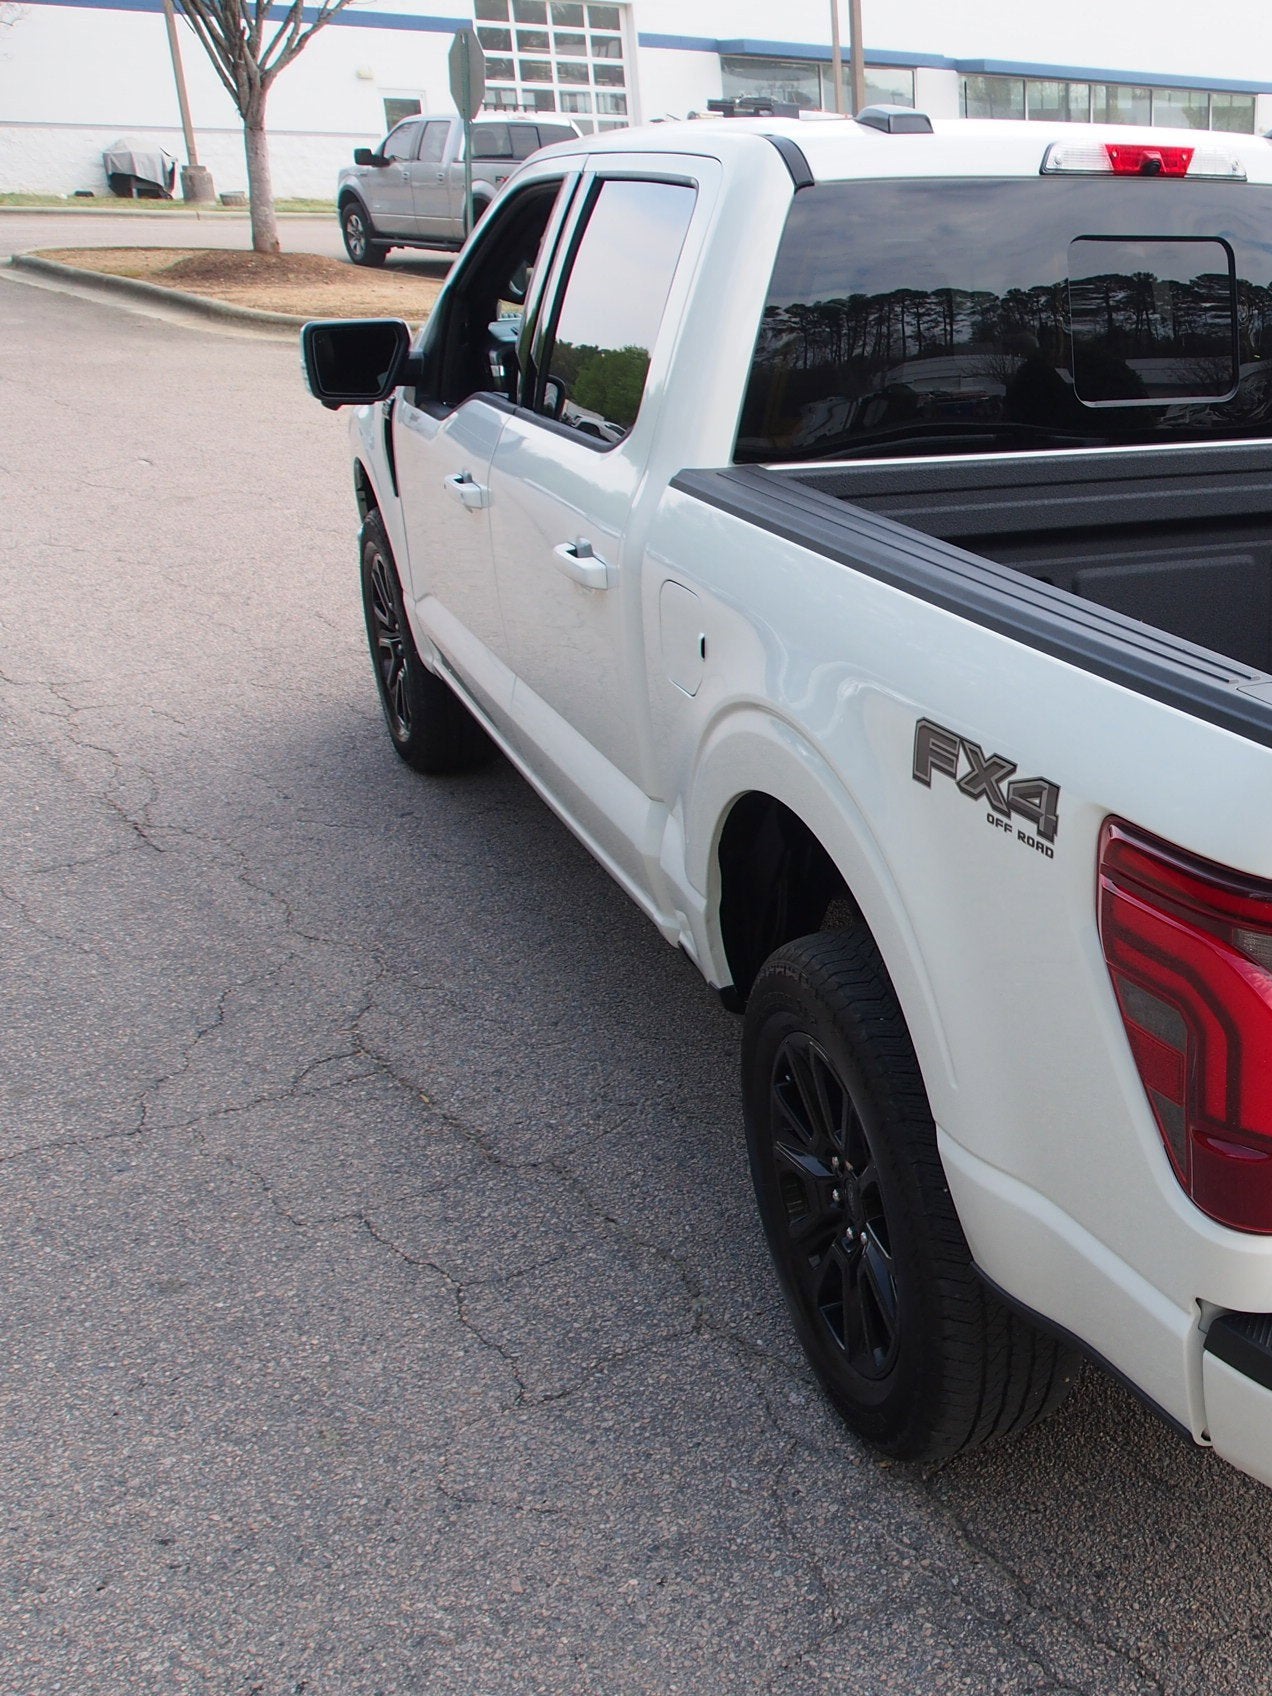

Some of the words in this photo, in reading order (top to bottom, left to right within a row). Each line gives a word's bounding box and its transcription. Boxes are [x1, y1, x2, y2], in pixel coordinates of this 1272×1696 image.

[912, 716, 1062, 845] FX4
[986, 812, 1012, 834] OFF
[1017, 829, 1054, 859] ROAD
